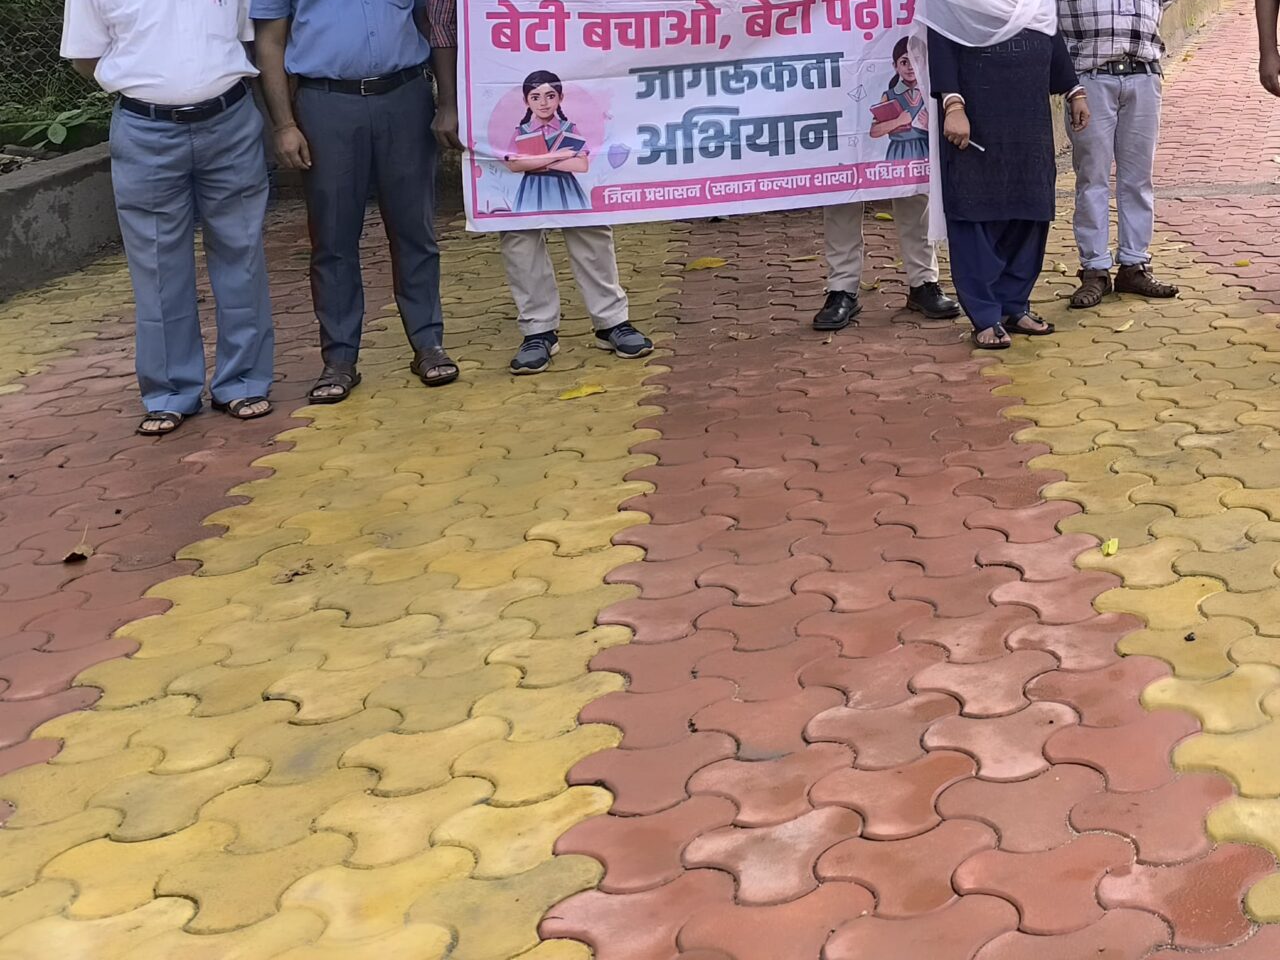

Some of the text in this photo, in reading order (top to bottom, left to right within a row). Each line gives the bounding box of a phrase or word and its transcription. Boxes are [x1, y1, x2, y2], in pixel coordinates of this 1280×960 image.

[628, 51, 845, 101] जागरूकता
[636, 105, 843, 166] अभियान
[603, 187, 642, 205] जिला
[645, 183, 702, 202] प्रशासन
[705, 178, 756, 200] (समाज
[759, 173, 812, 192] कल्याण
[814, 166, 863, 187] शाखा),
